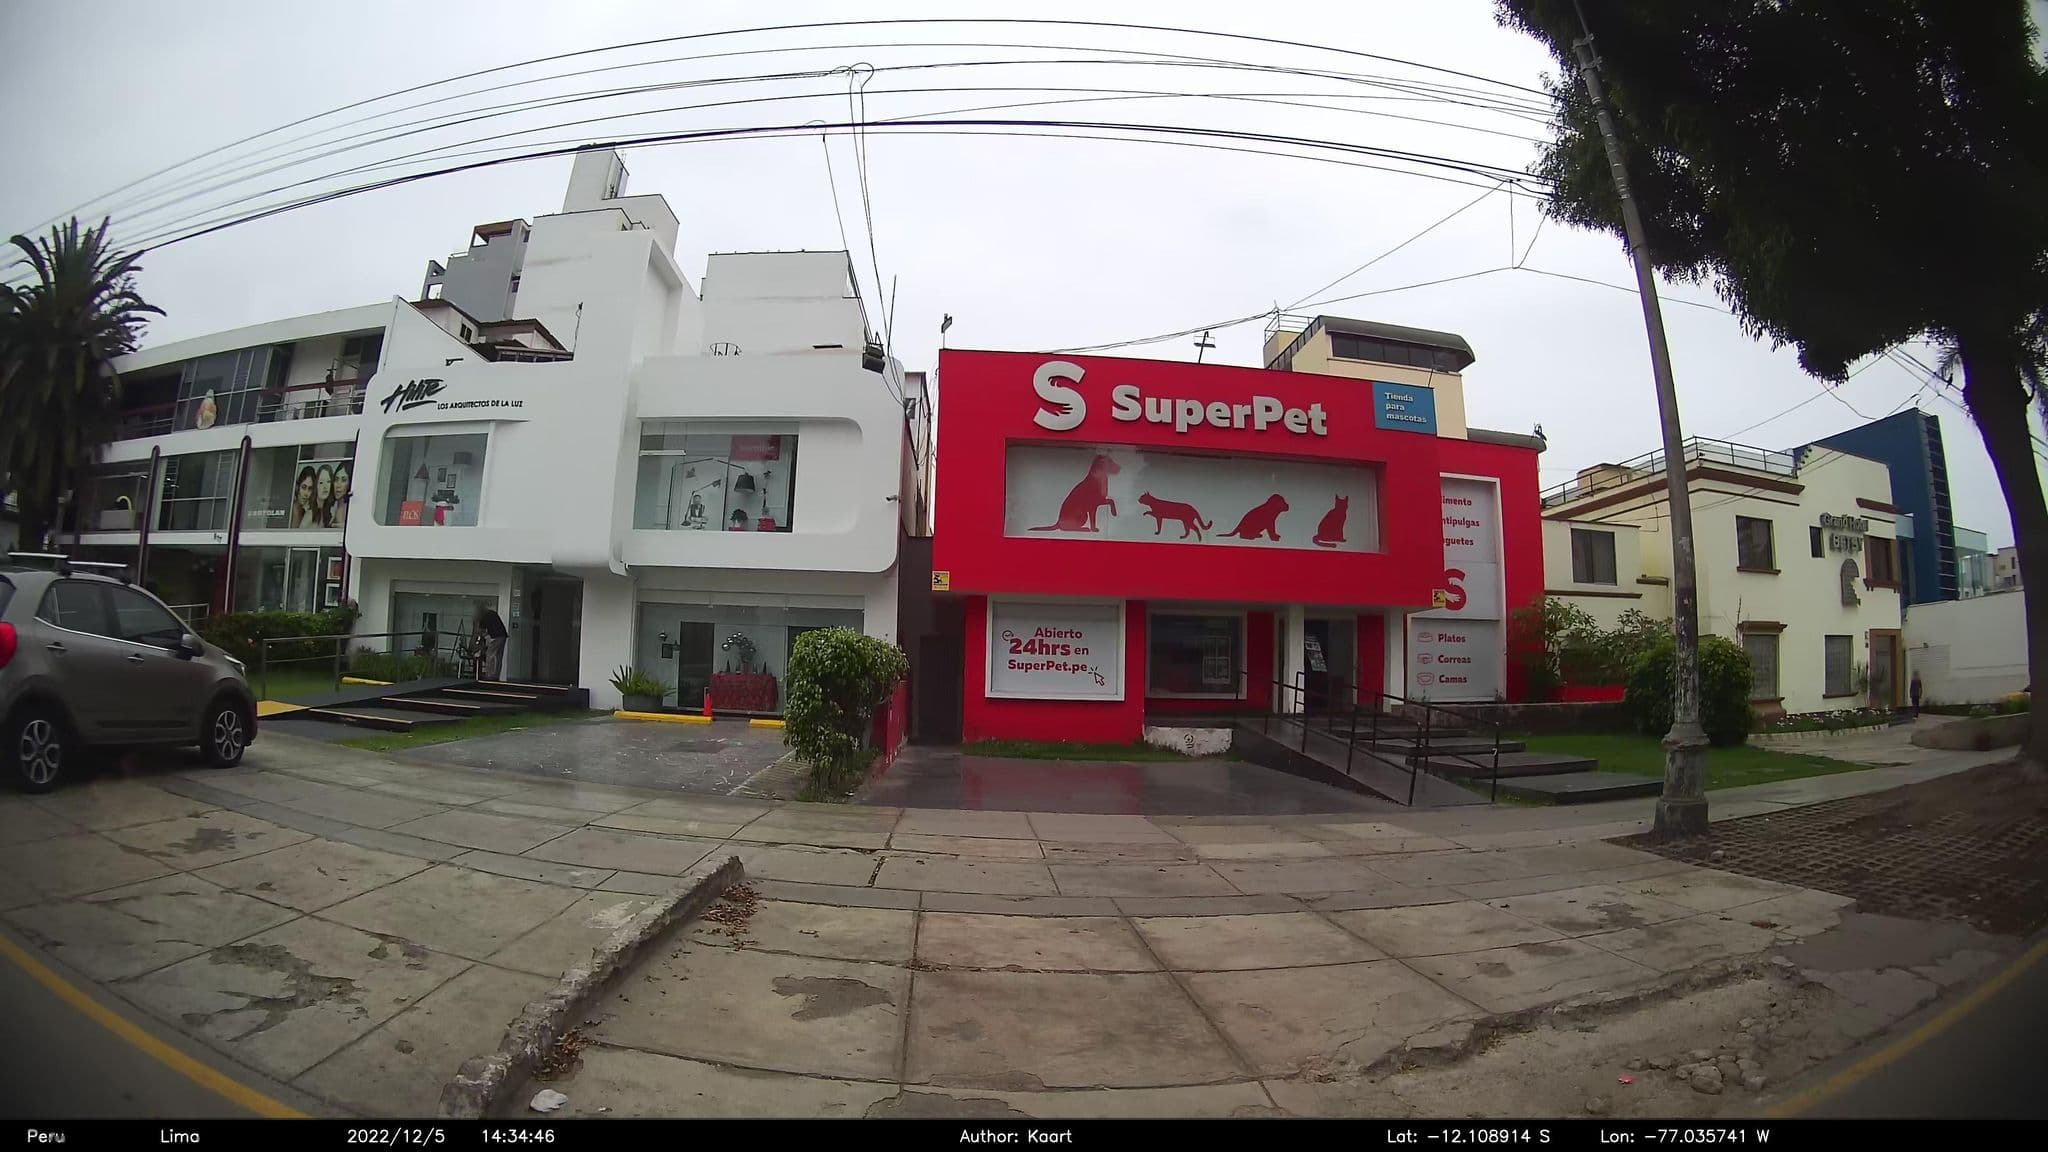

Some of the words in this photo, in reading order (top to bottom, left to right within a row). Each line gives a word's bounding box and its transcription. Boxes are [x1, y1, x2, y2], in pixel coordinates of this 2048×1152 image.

[1384, 392, 1414, 402] Tienda
[437, 402, 448, 410] LOS
[450, 400, 490, 409] ARQUITECTOS
[511, 400, 523, 408] LUZ
[1111, 384, 1328, 436] SuperPet
[1385, 403, 1405, 411] para
[1386, 413, 1427, 423] mascotas
[1034, 627, 1083, 639] Abierto
[1438, 633, 1466, 643] Platos
[1009, 638, 1071, 656] 24hrs
[1074, 647, 1089, 655] en
[1438, 655, 1471, 664] Correas
[1008, 659, 1088, 674] SuperPet.pe
[1439, 675, 1467, 684] Camas
